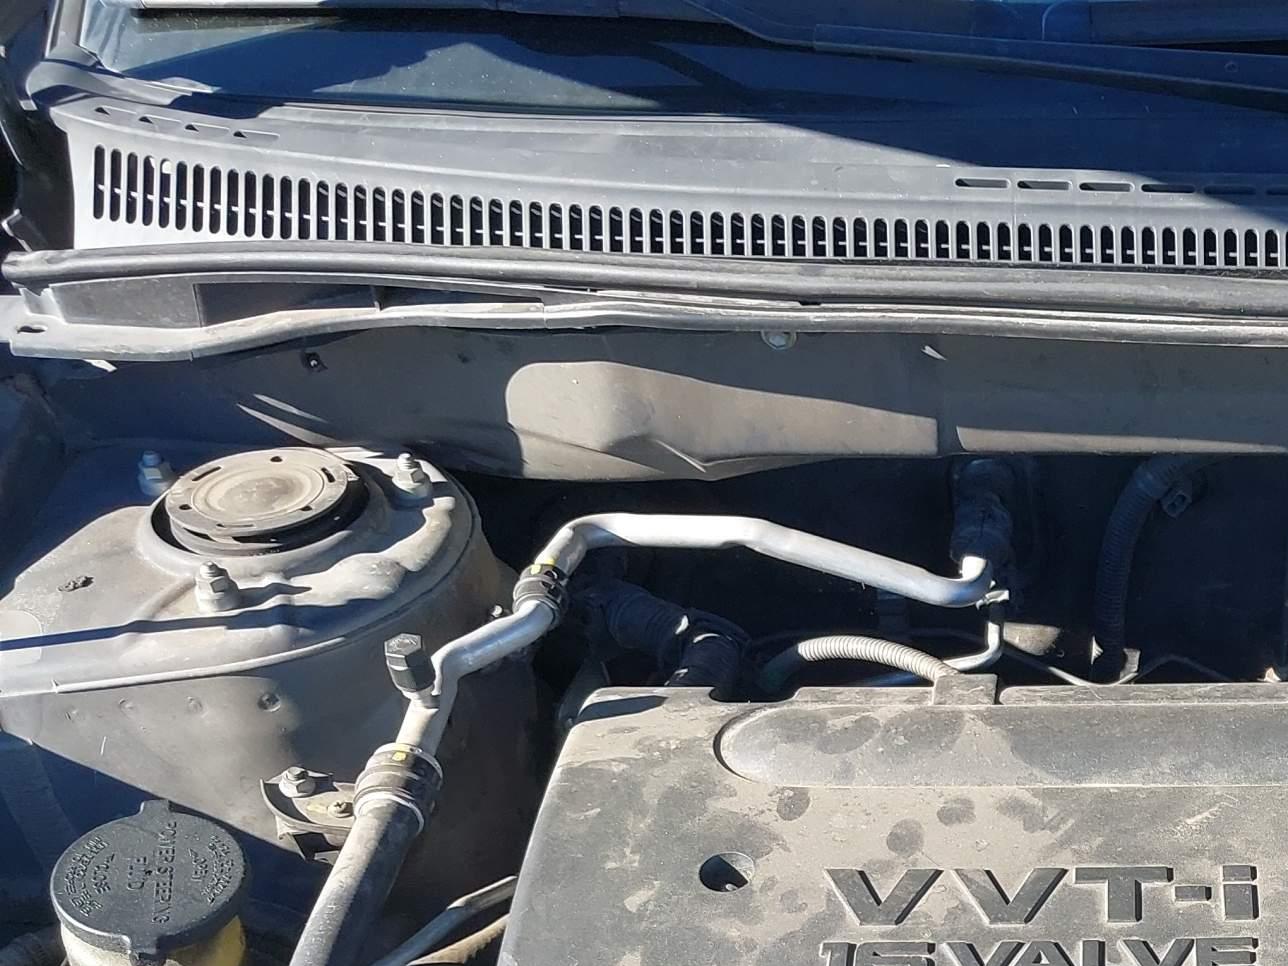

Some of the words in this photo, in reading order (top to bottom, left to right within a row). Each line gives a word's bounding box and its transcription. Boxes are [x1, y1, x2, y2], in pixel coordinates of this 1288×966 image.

[157, 821, 177, 863] POWER
[151, 865, 175, 924] STEERING
[825, 866, 1259, 926] VVT-i
